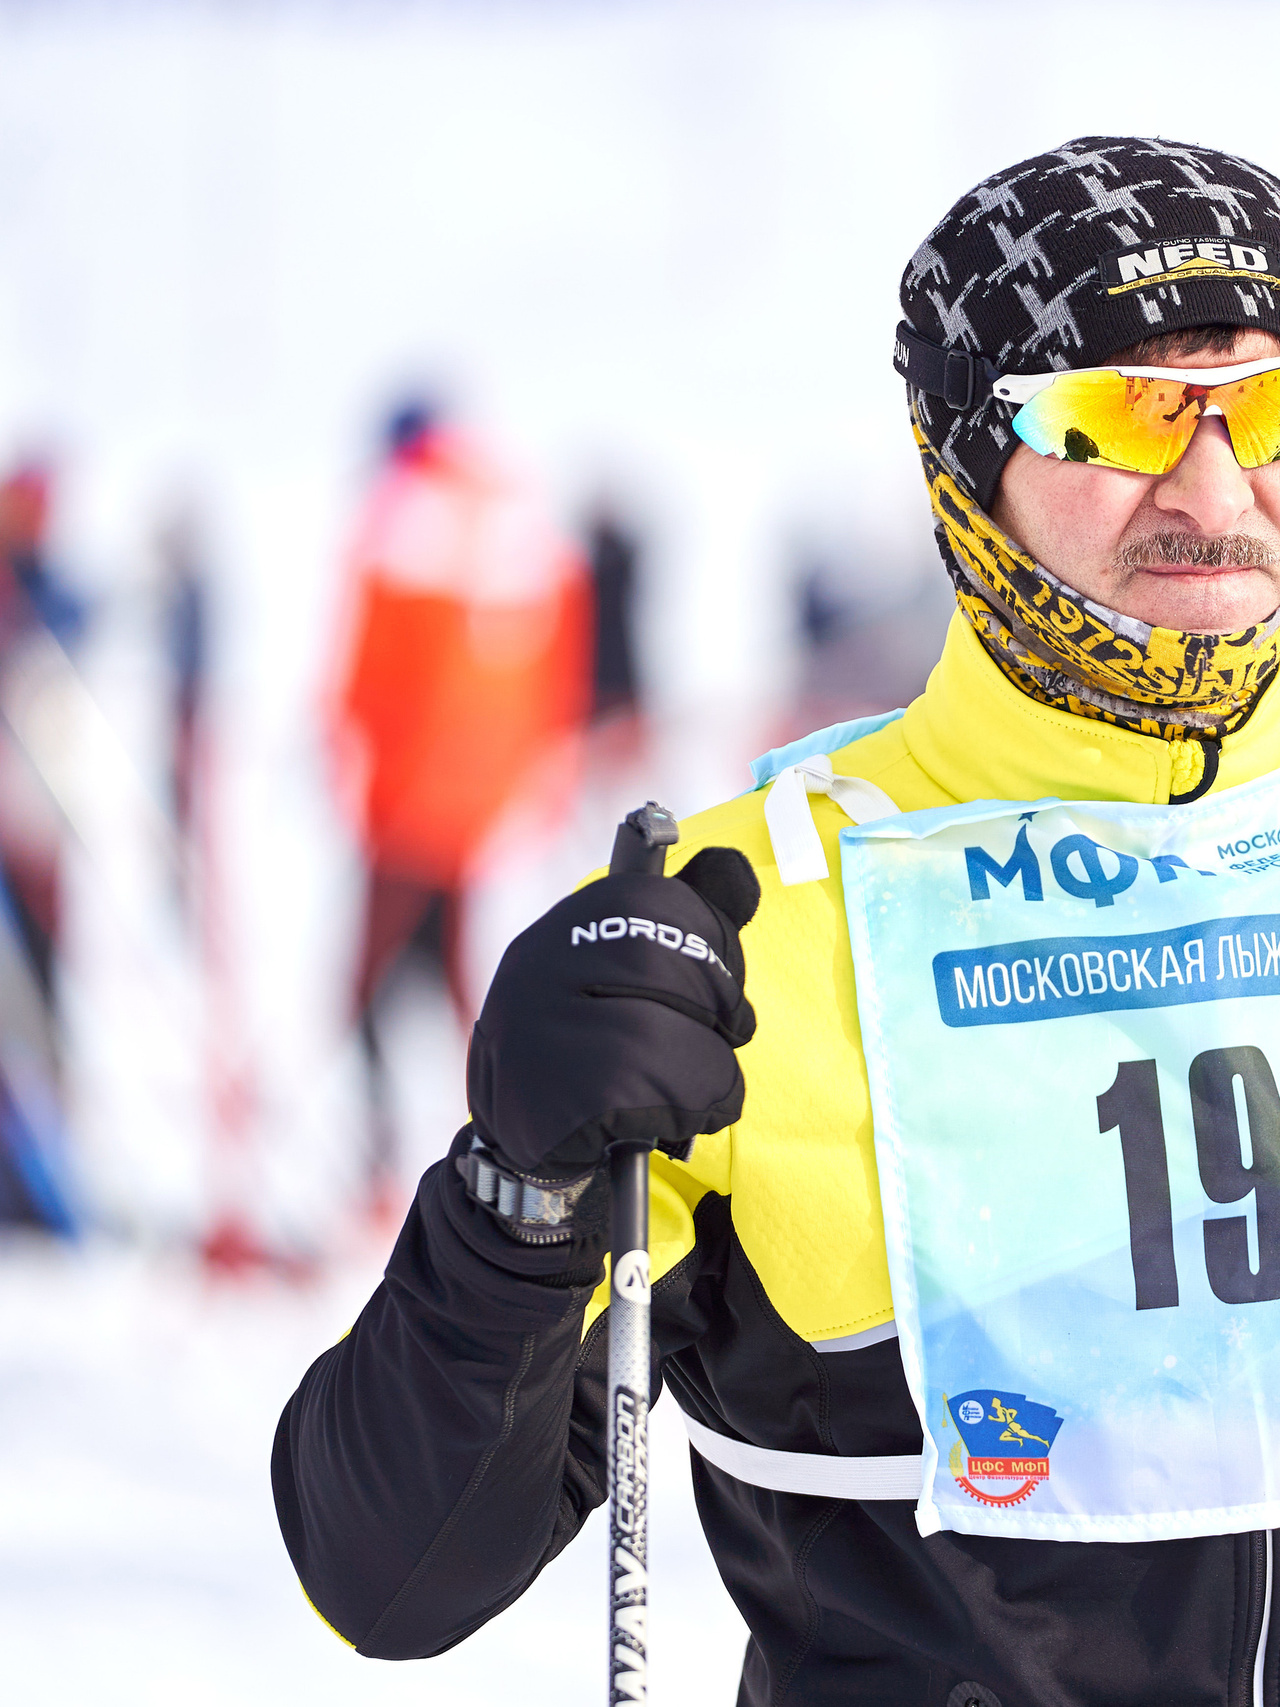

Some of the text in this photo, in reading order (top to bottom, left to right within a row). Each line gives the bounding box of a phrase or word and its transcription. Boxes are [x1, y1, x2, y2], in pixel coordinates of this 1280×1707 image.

[1154, 238, 1191, 247] YOUNG
[1117, 243, 1268, 283] NEED
[954, 938, 1206, 1009] МОСКОВСКАЯ
[616, 1392, 635, 1534] CARBON
[971, 1460, 1047, 1475] ЦФС МФП
